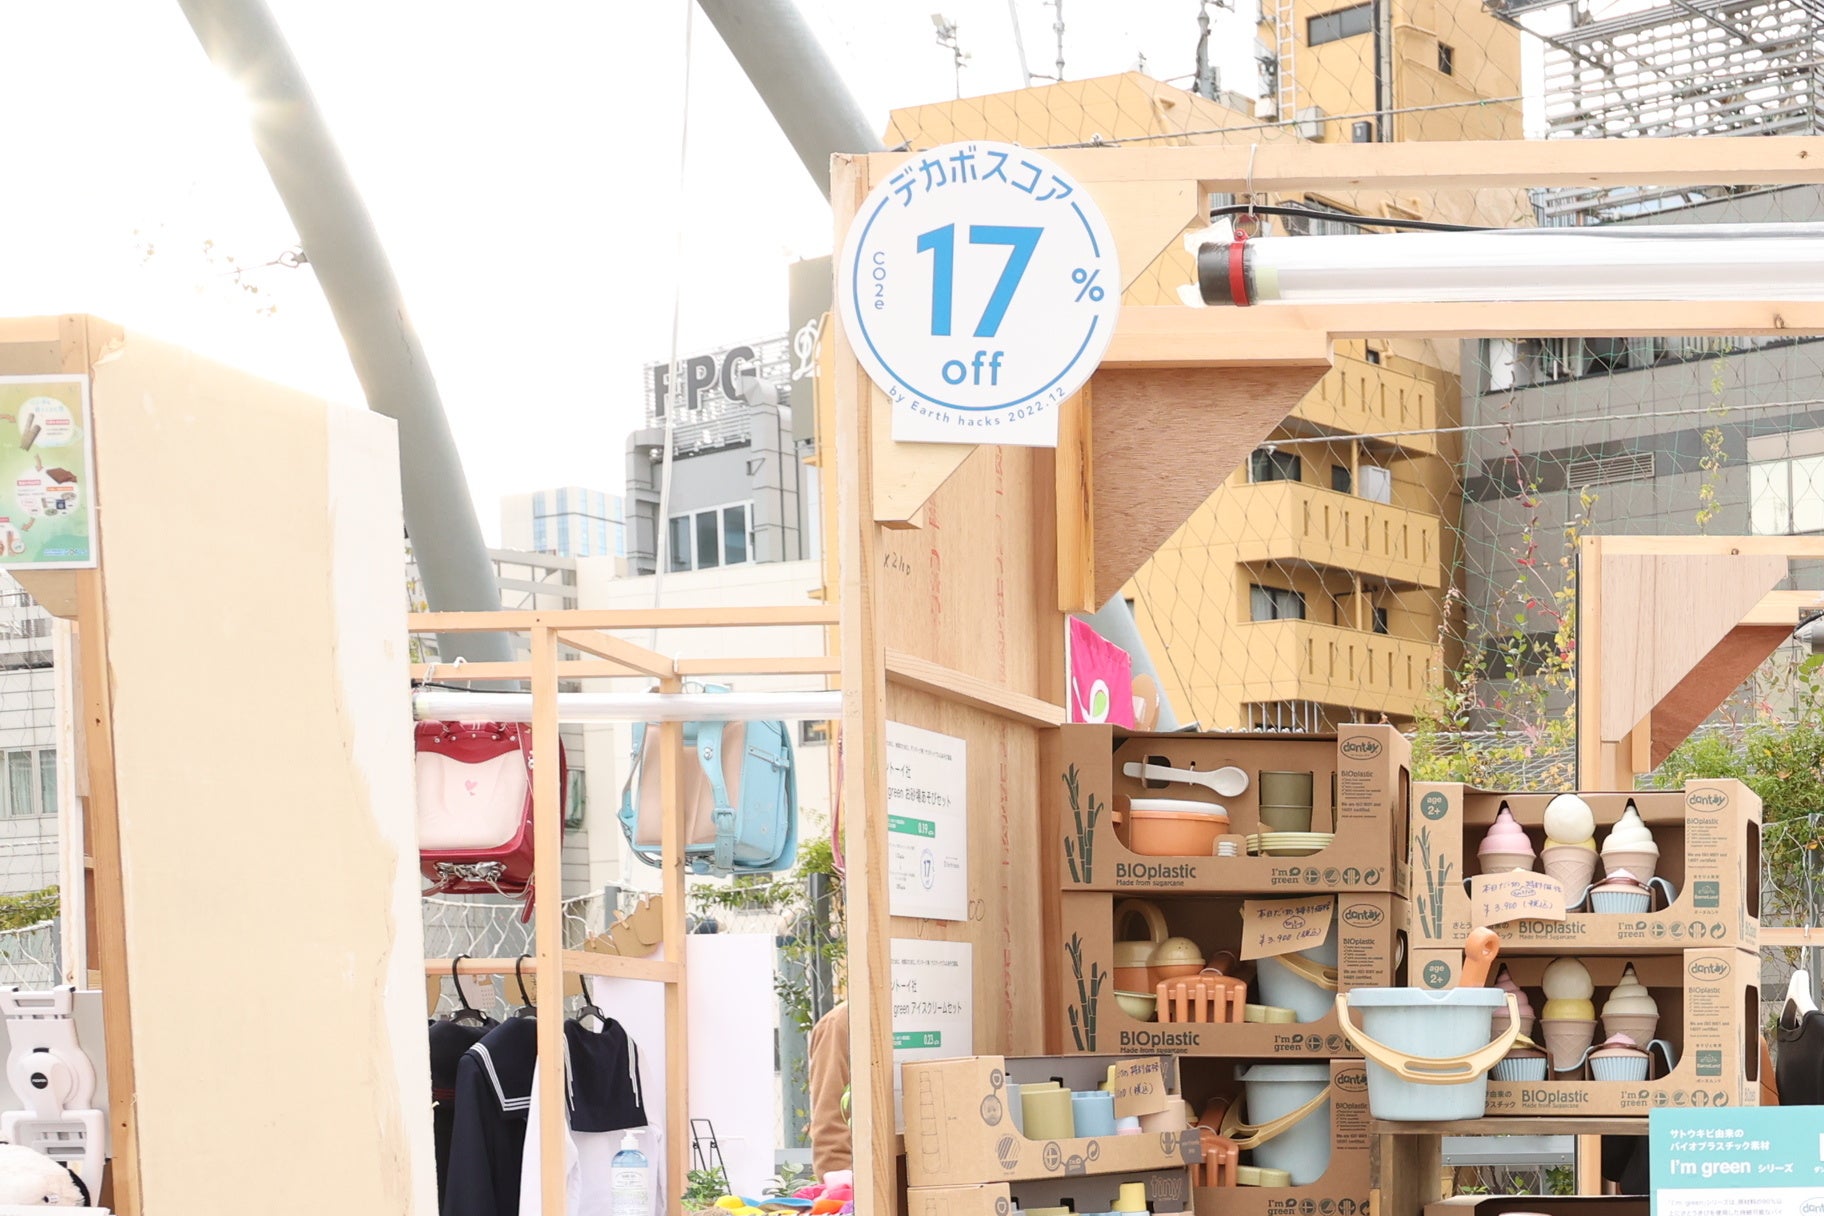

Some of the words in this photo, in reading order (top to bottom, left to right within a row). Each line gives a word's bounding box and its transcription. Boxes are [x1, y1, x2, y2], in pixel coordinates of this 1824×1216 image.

[889, 145, 1074, 207] デカボスコア
[916, 222, 1045, 338] 17
[1071, 268, 1105, 303] %
[941, 350, 1004, 386] off
[889, 385, 905, 404] by
[911, 400, 950, 424] Earth
[957, 414, 1001, 427] hacks
[1008, 387, 1066, 423] 2022.12
[1343, 742, 1379, 754] dantoy
[1427, 797, 1442, 805] age
[1689, 794, 1726, 806] dantoy
[1427, 806, 1441, 815] 2+
[1116, 863, 1197, 881] BIOplastic
[1271, 868, 1288, 877] I'm
[1271, 876, 1299, 886] green
[1345, 910, 1381, 922] dantoy
[1519, 921, 1586, 936] BIOplastic
[1618, 922, 1633, 930] I'm
[1618, 931, 1645, 939] green
[1691, 963, 1727, 975] dantoy
[1430, 975, 1444, 984] 2+
[1120, 1031, 1200, 1048] BIOplastic
[1275, 1035, 1291, 1043] I'm
[1274, 1043, 1300, 1052] green
[1337, 1072, 1368, 1086] danto
[1522, 1090, 1588, 1104] BIOplastic
[1621, 1091, 1637, 1099] I'm
[1620, 1100, 1648, 1108] green
[1670, 1128, 1744, 1139] サトウキビ由来の
[1670, 1140, 1770, 1151] バイオプラスチック素材
[1670, 1159, 1696, 1175] I'm
[1701, 1160, 1751, 1178] green
[1758, 1162, 1794, 1173] シリーズ
[1150, 1174, 1183, 1200] tiny
[1267, 1207, 1295, 1216] green
